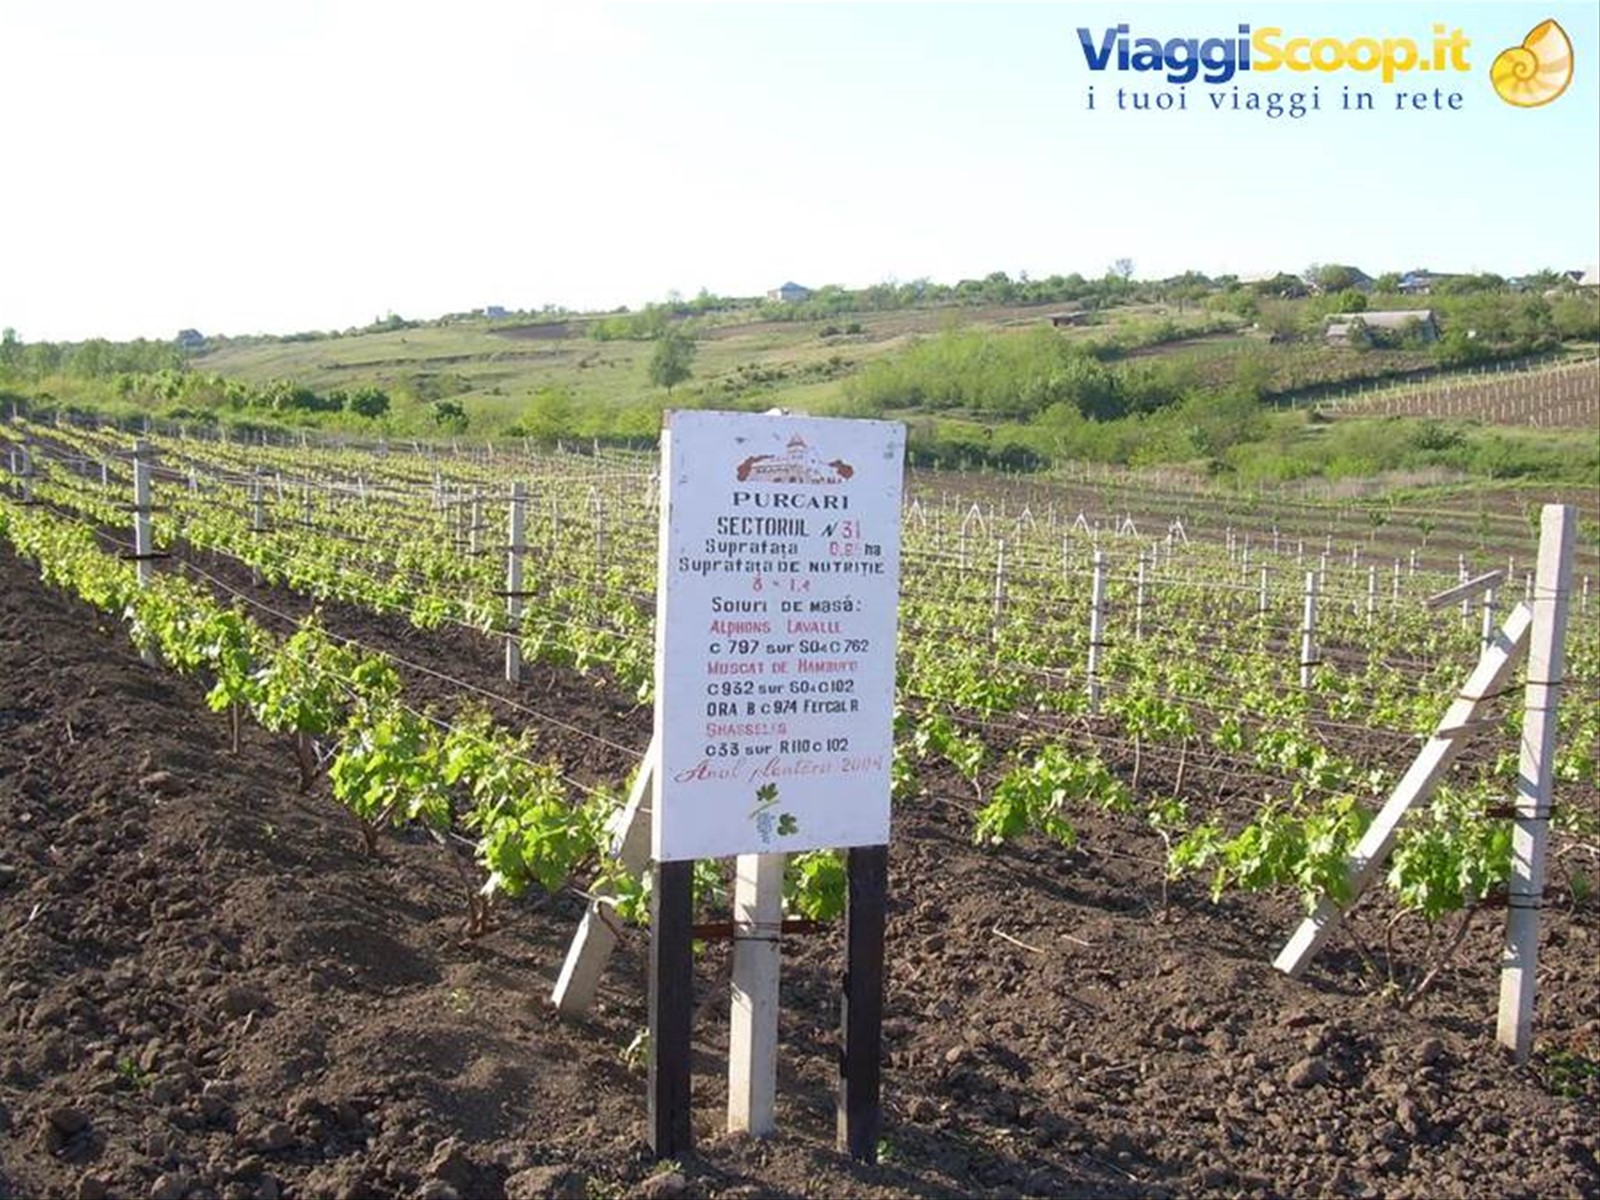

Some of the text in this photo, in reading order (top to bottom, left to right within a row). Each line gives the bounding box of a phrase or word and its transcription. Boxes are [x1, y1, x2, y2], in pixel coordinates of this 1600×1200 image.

[732, 491, 850, 510] PURCARI
[717, 516, 810, 537] SECTORUL
[864, 543, 882, 556] ha
[781, 600, 803, 612] DE
[728, 640, 759, 655] 797
[765, 642, 795, 655] sur
[707, 660, 764, 675] MUSCAT
[772, 661, 789, 674] DE
[758, 684, 785, 695] sur
[747, 702, 756, 716] B
[745, 744, 772, 756] sur
